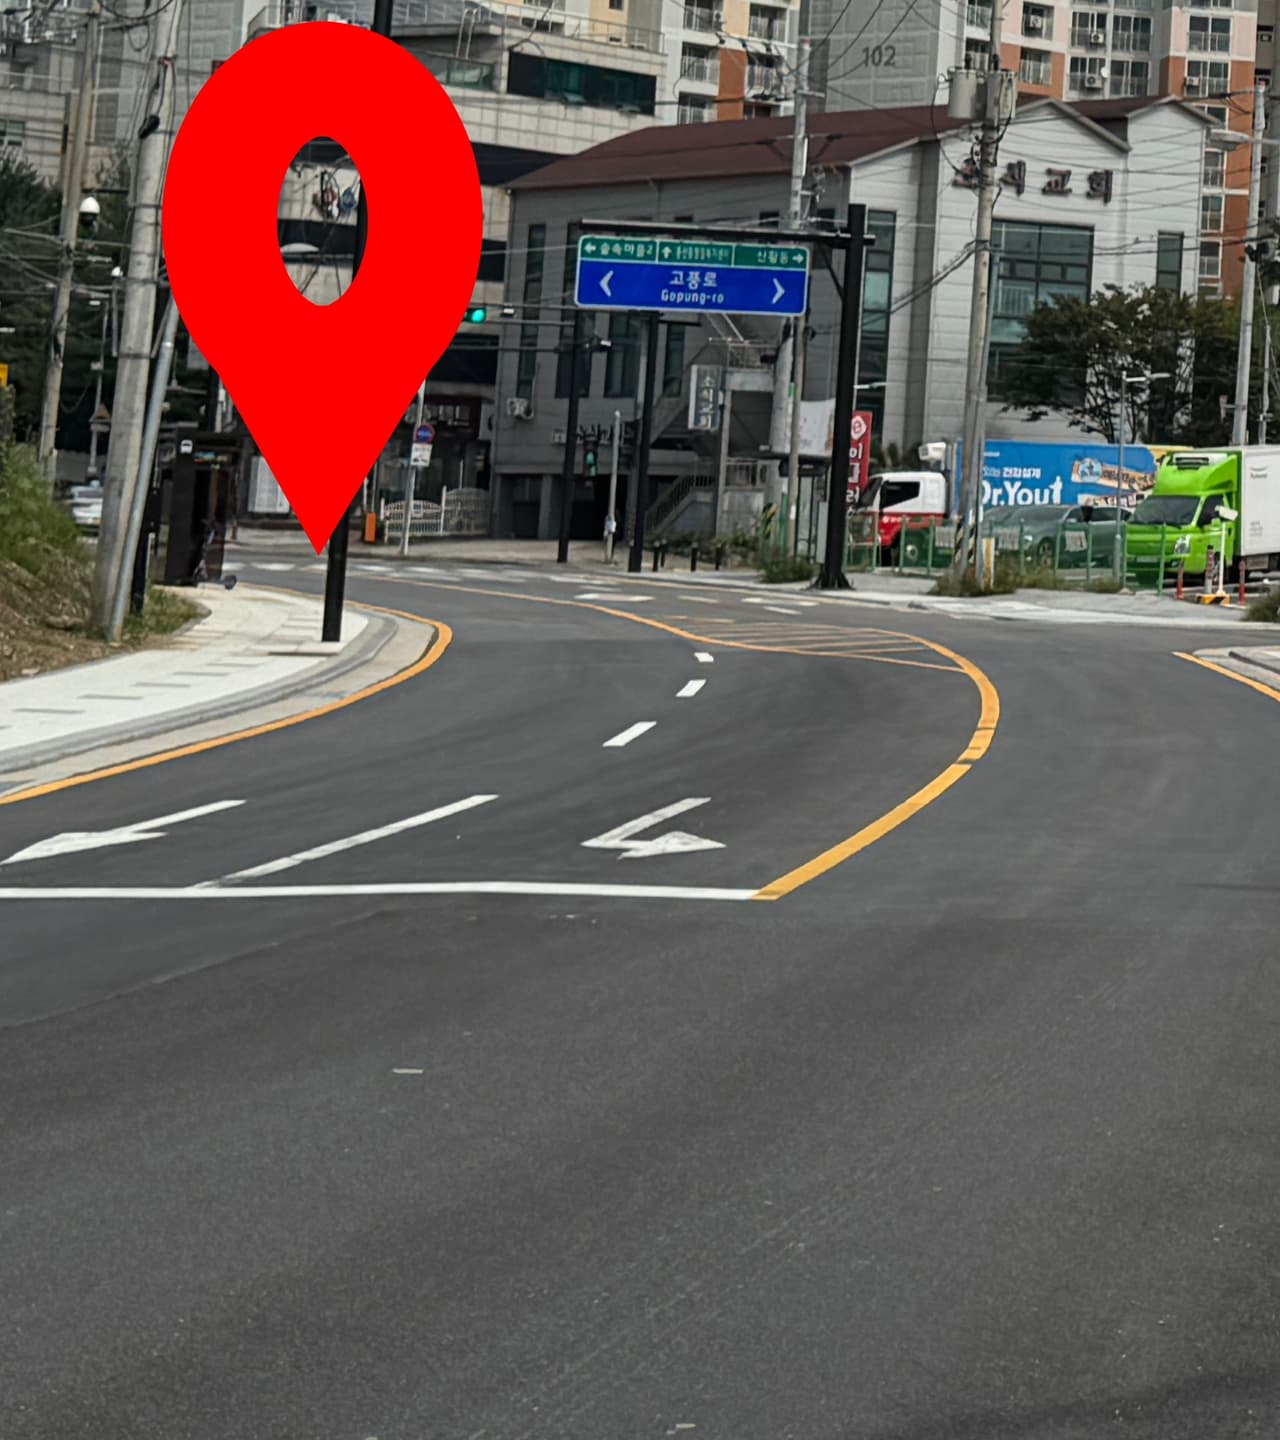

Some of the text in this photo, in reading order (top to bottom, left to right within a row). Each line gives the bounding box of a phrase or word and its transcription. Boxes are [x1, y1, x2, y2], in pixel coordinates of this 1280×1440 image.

[862, 45, 896, 67] 102
[669, 270, 718, 290] 고풍로
[661, 289, 725, 306] Gopung-ro
